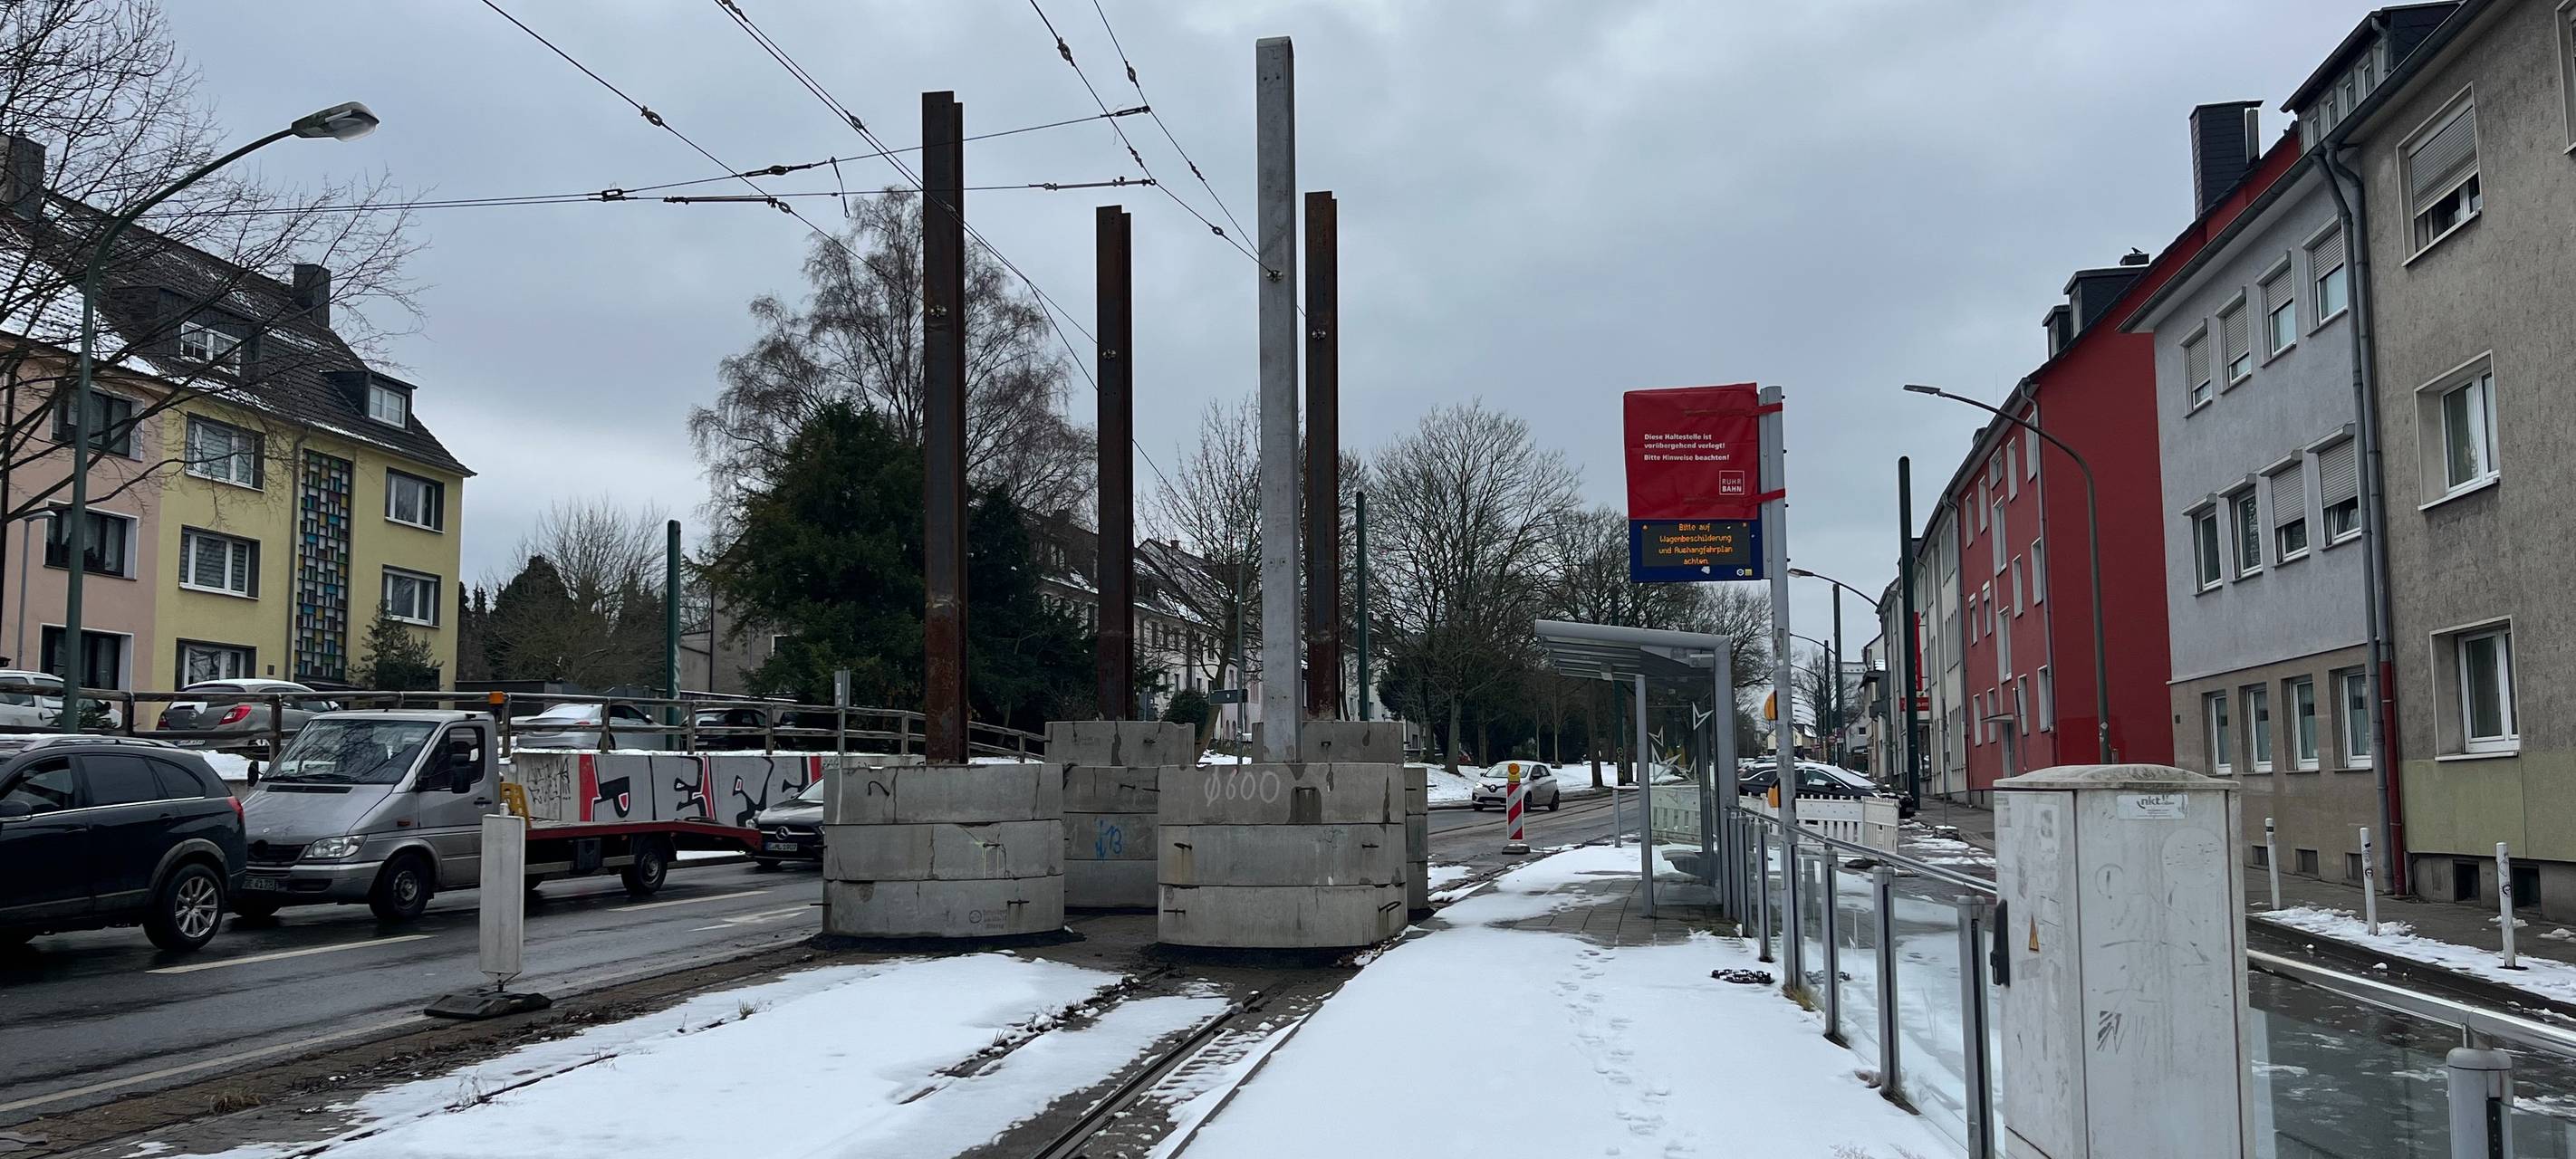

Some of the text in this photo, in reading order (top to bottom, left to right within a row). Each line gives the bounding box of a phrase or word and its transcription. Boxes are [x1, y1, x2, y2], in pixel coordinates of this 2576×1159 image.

[1678, 523, 1710, 532] Bitte auf
[1659, 535, 1732, 543] Wagenbeschilderung
[1674, 546, 1733, 554] Aushangfahrplan
[2140, 796, 2161, 806] nkt
